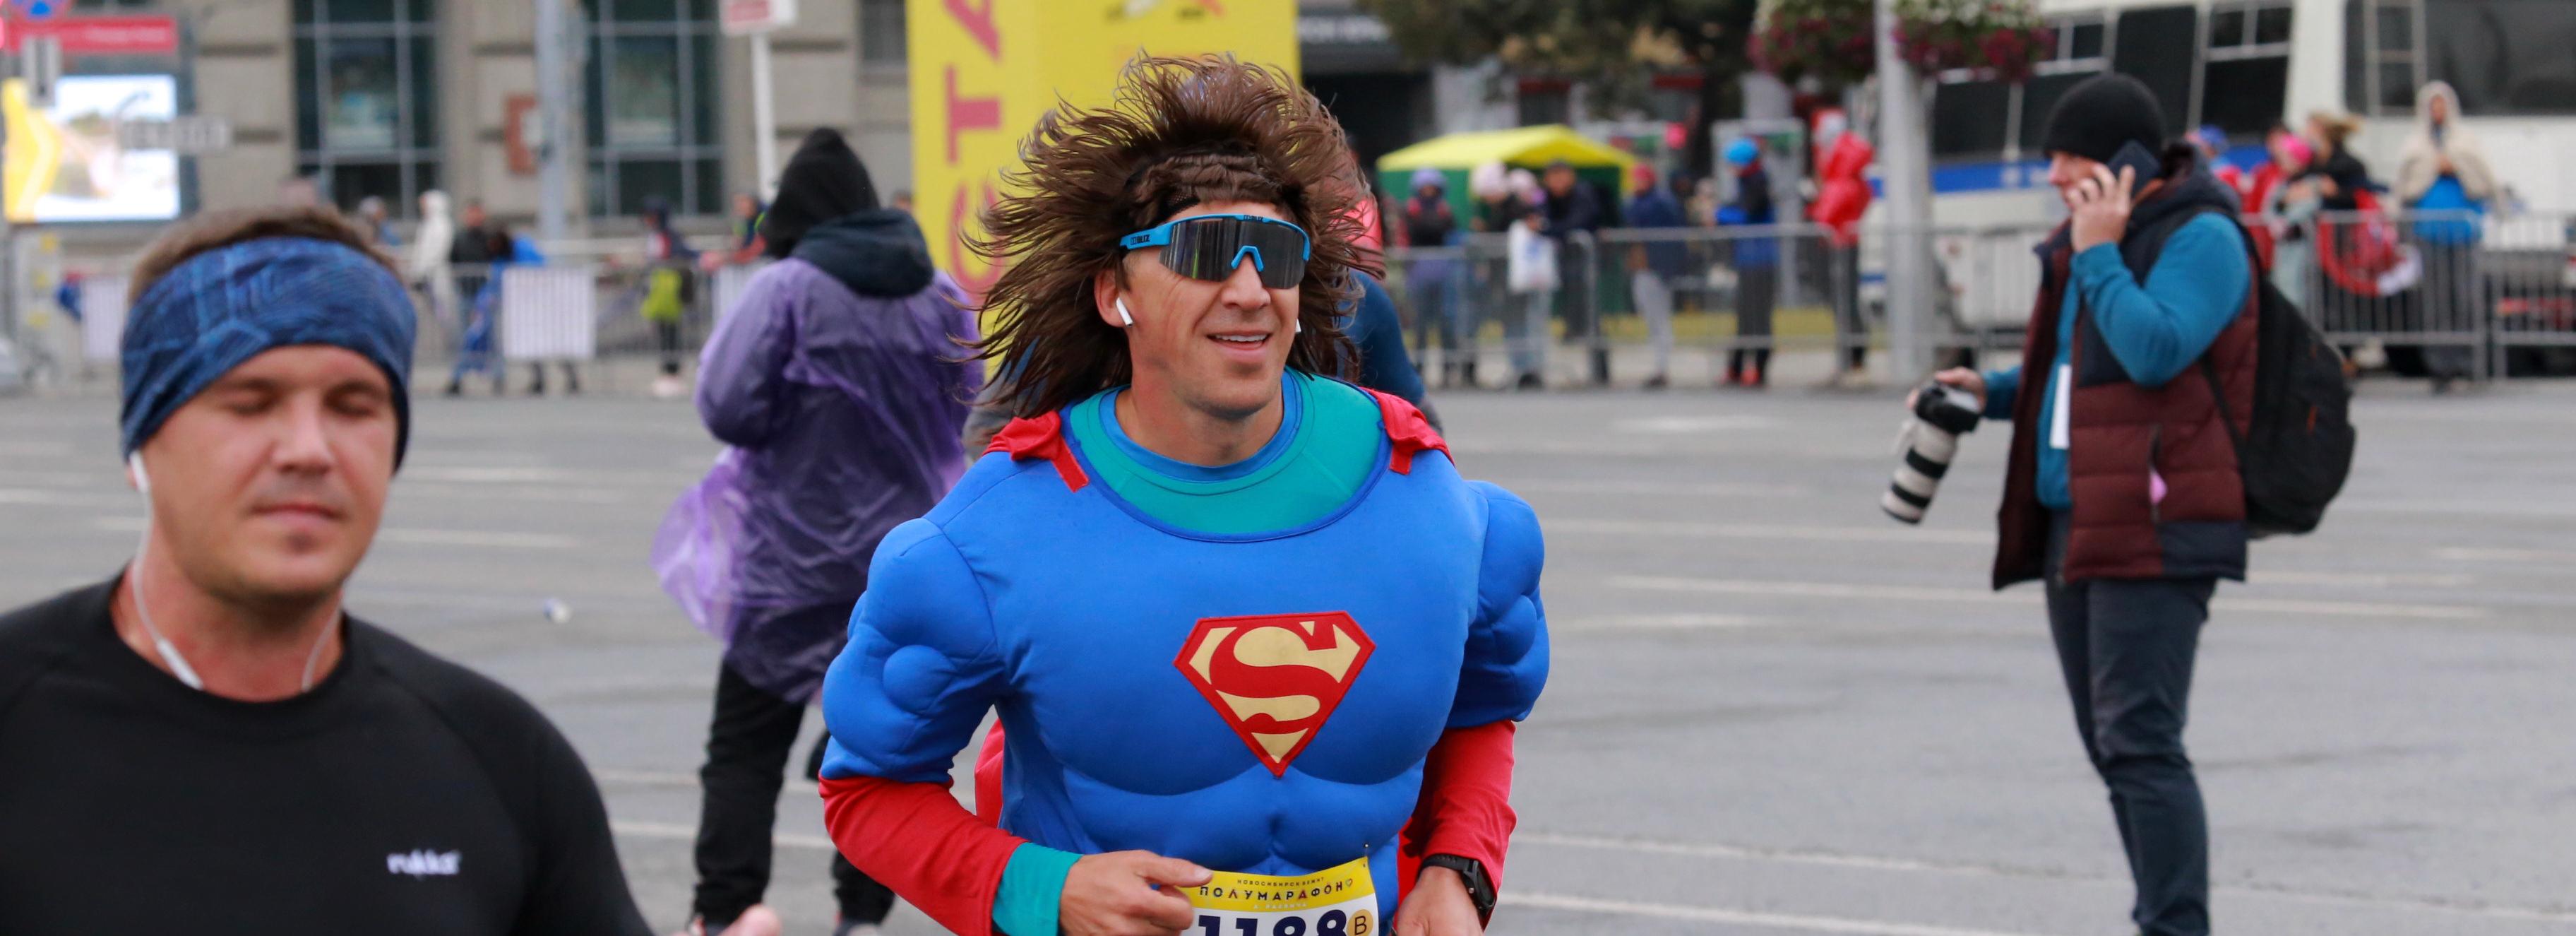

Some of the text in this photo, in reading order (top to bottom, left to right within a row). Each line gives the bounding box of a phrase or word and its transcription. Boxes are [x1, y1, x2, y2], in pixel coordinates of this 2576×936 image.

[1208, 619, 1341, 735] S
[1199, 881, 1343, 901] ПОЛУМАРАФОН
[1237, 879, 1300, 887] НОВОСИБИРСК
